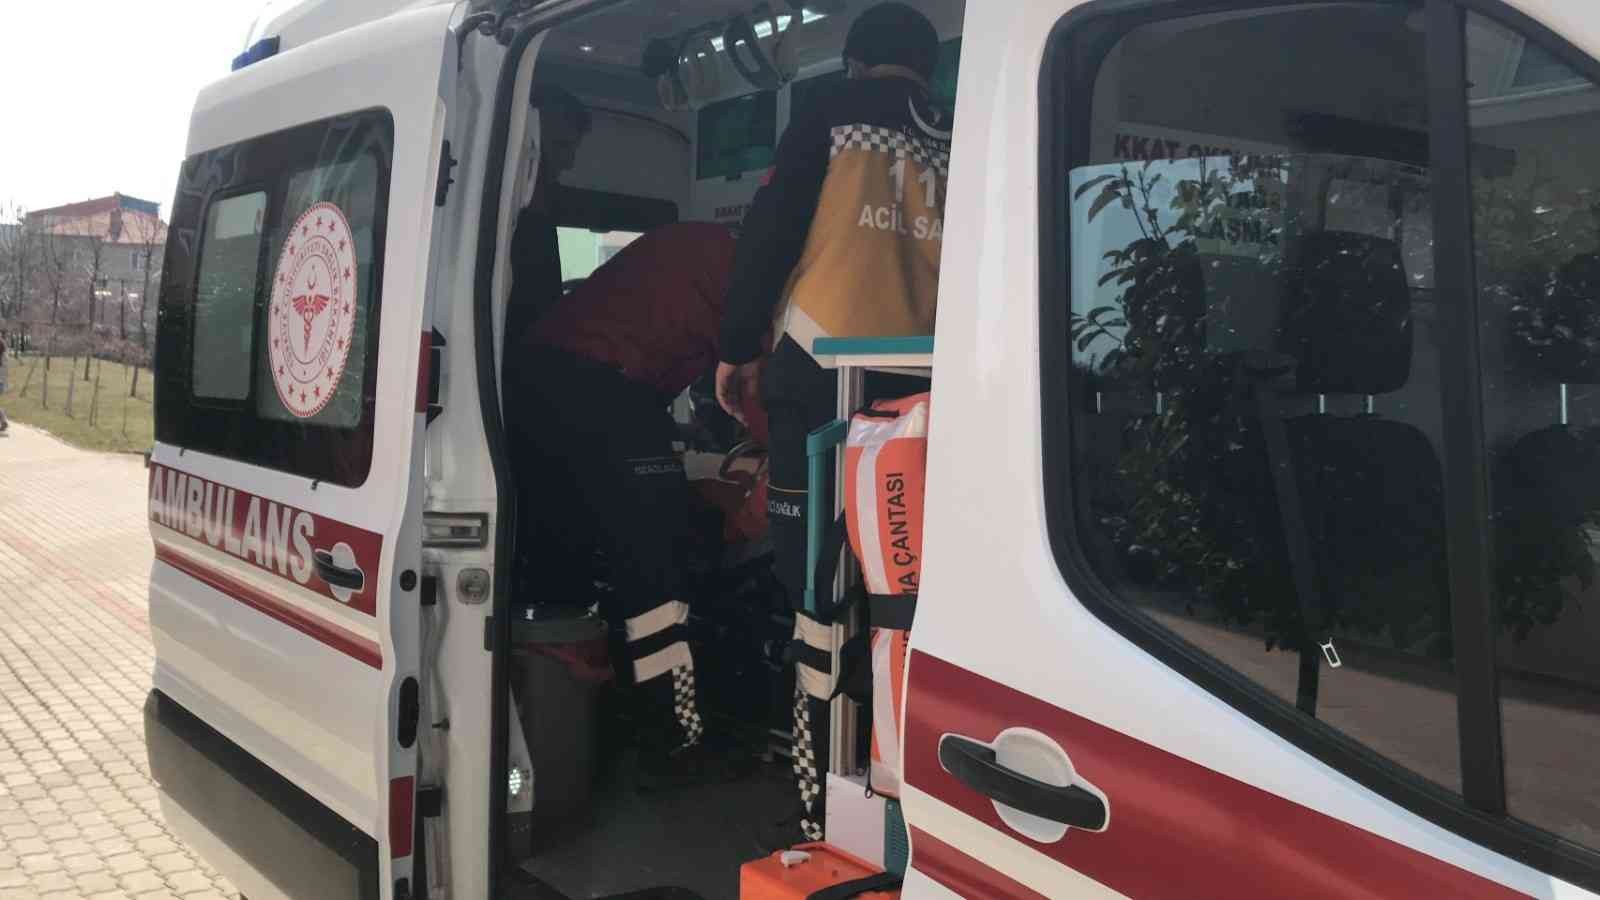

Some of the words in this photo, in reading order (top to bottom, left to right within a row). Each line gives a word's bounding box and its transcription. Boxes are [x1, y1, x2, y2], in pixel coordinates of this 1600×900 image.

[858, 203, 907, 235] ACİL
[889, 159, 950, 208] 11
[150, 464, 315, 585] AMBULANS
[886, 472, 918, 566] ÇANTASI
